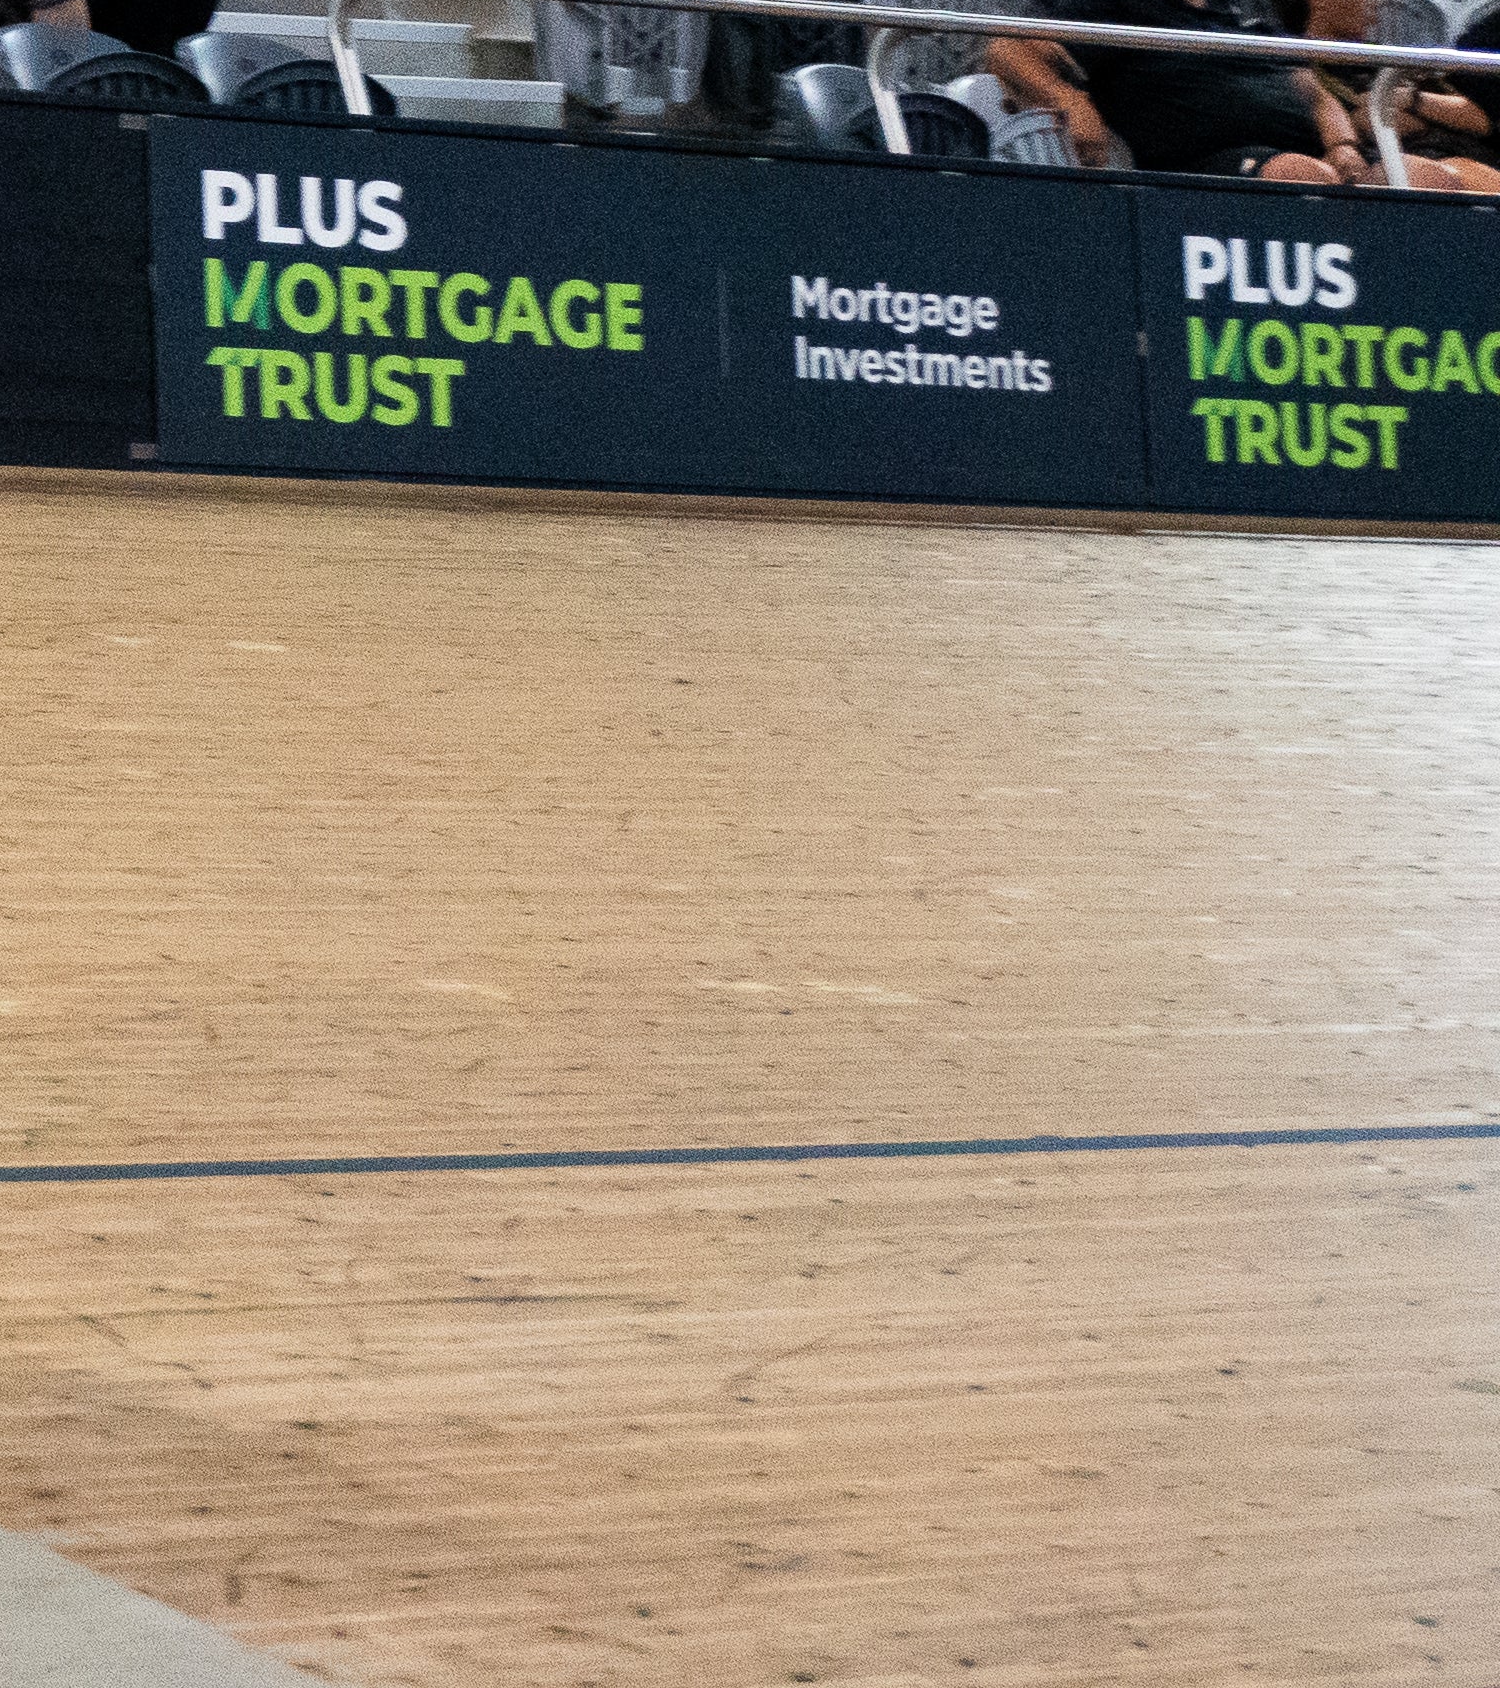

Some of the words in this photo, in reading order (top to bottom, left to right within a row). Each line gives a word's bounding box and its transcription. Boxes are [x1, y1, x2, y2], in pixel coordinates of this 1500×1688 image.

[201, 170, 408, 252] PLUS
[203, 258, 645, 351] MORTGAGE
[791, 275, 1000, 336] Mortgage
[1182, 235, 1357, 308] PLUS
[205, 346, 465, 427] TRUST
[794, 336, 1053, 392] Investments
[1192, 398, 1409, 469] TRUST
